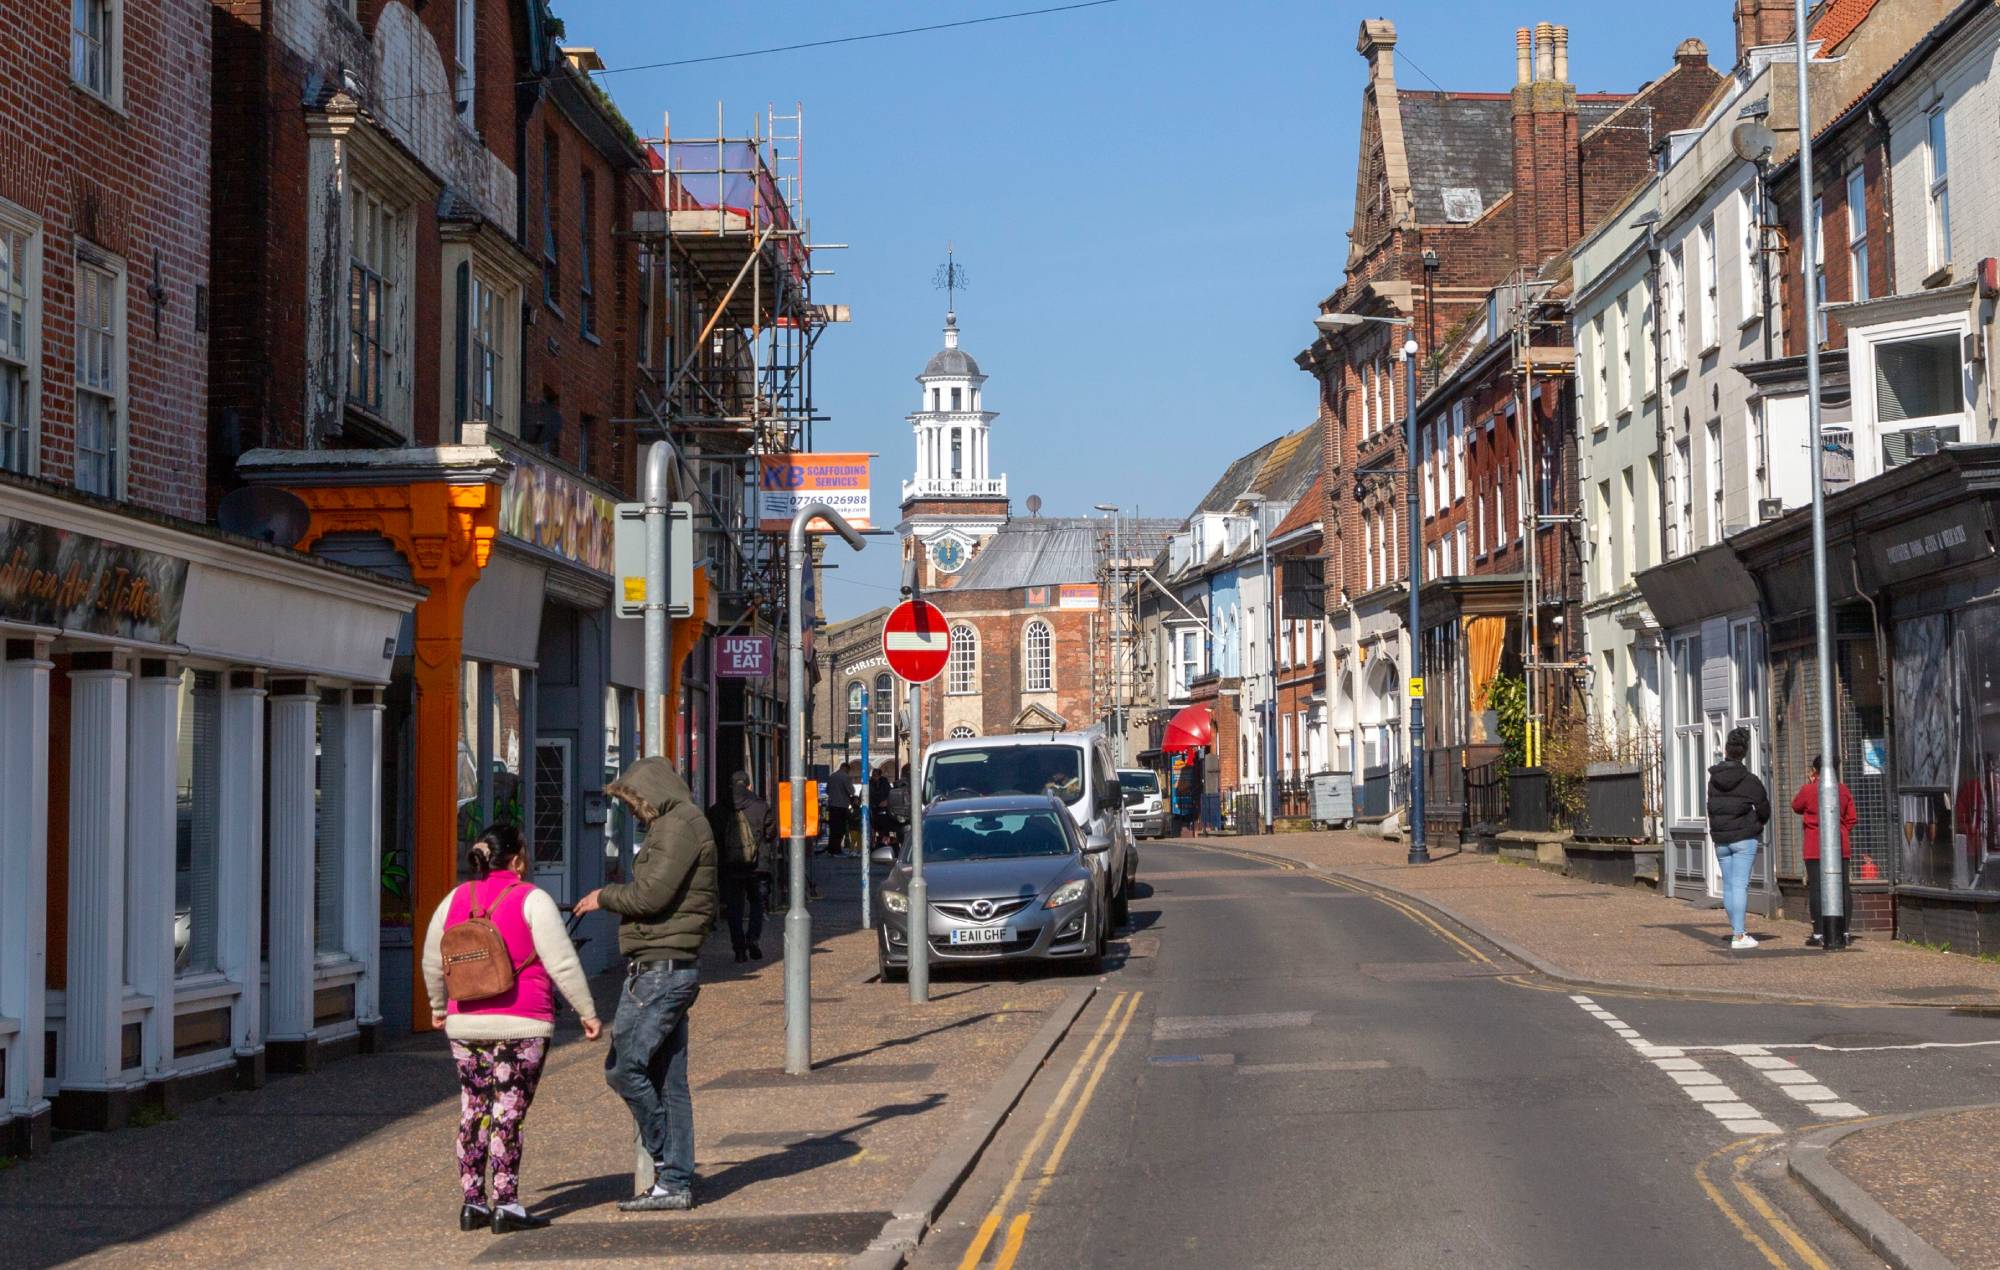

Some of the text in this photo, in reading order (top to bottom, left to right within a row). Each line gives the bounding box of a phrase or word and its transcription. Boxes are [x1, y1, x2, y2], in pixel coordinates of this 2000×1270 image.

[763, 465, 866, 488] KB SCAFFOLDING
[815, 477, 859, 487] SERVICES
[790, 495, 867, 506] 07765 026988
[723, 639, 763, 654] JUST
[733, 654, 763, 668] EAT
[984, 929, 1007, 941] GHF
